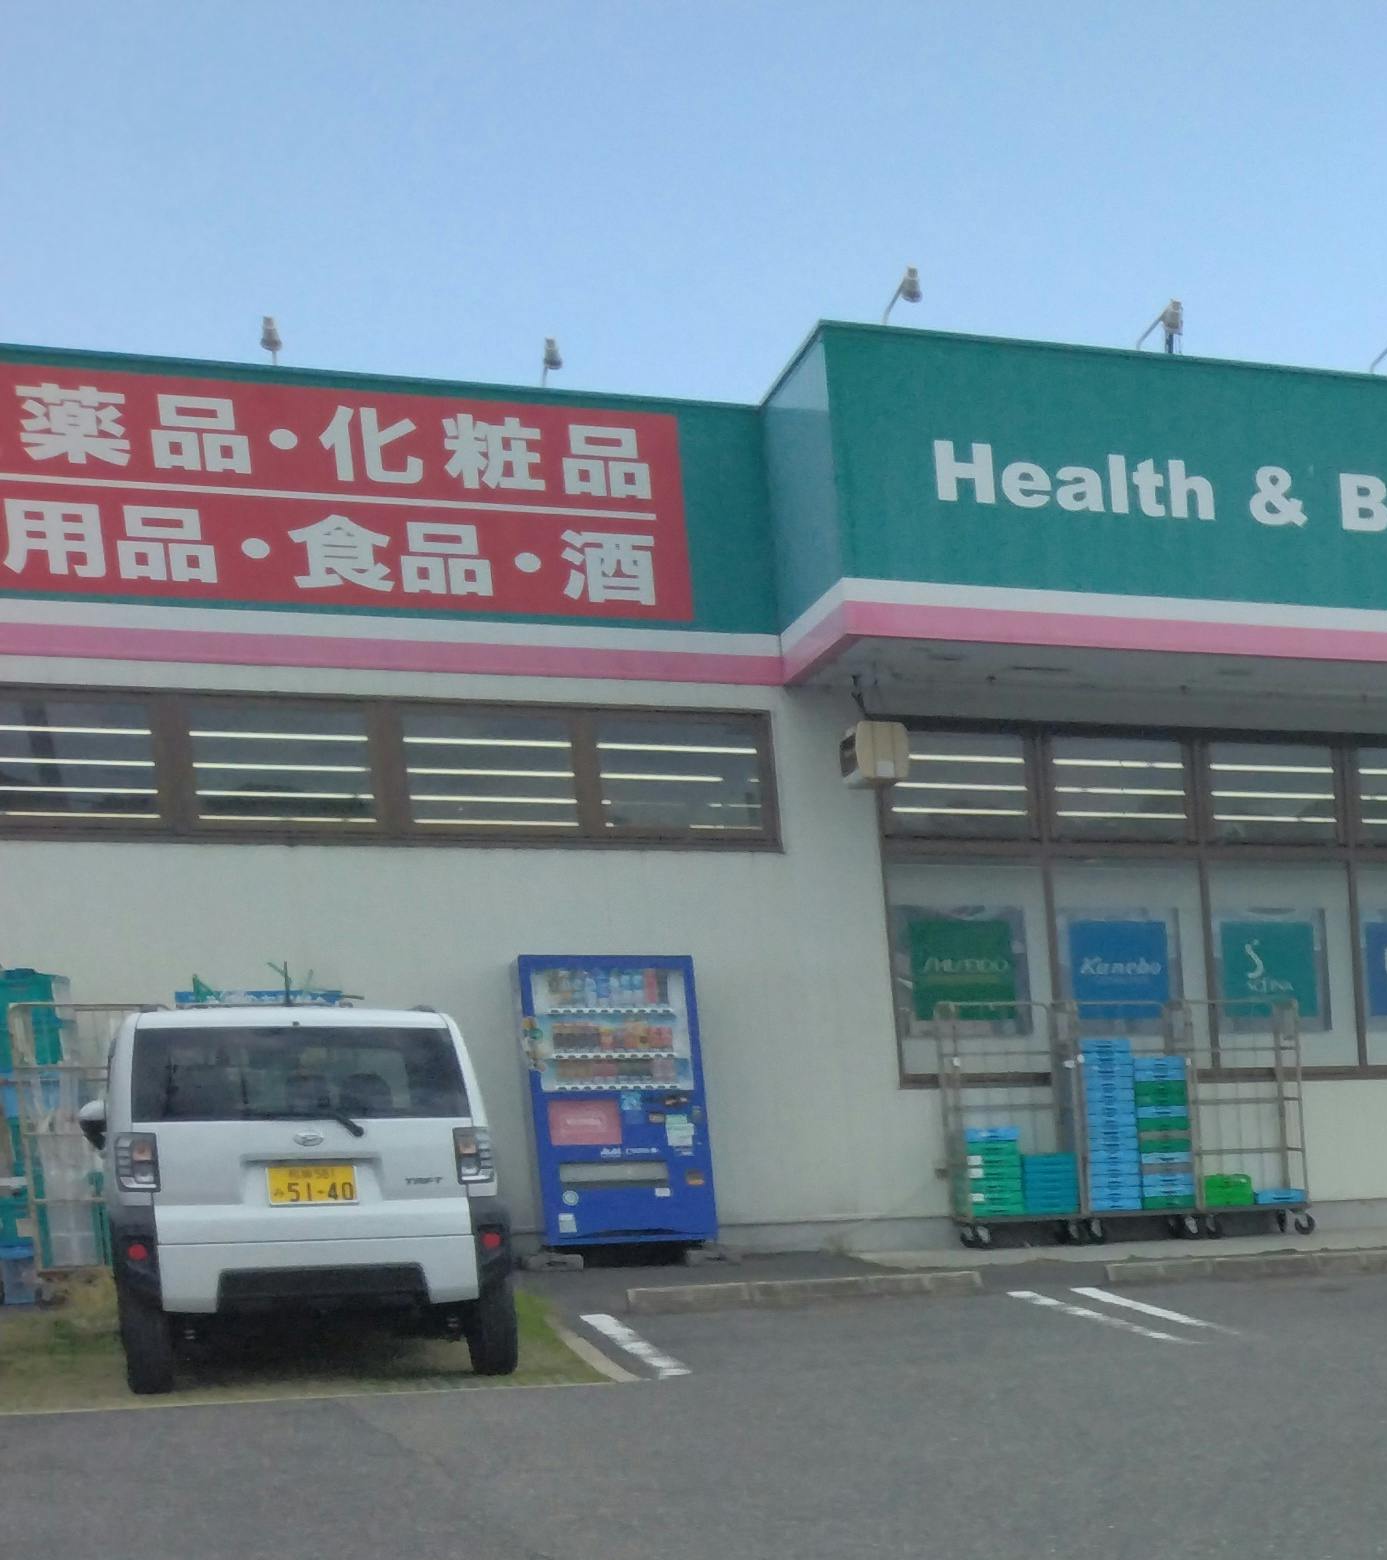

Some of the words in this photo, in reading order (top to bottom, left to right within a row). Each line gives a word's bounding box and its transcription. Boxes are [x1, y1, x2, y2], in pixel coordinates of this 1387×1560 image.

[15, 381, 651, 500] 薬品・化粧品
[933, 439, 1216, 520] Health
[1249, 465, 1308, 527] &
[1080, 957, 1162, 976] Kanebo
[287, 1182, 354, 1202] 51-40
